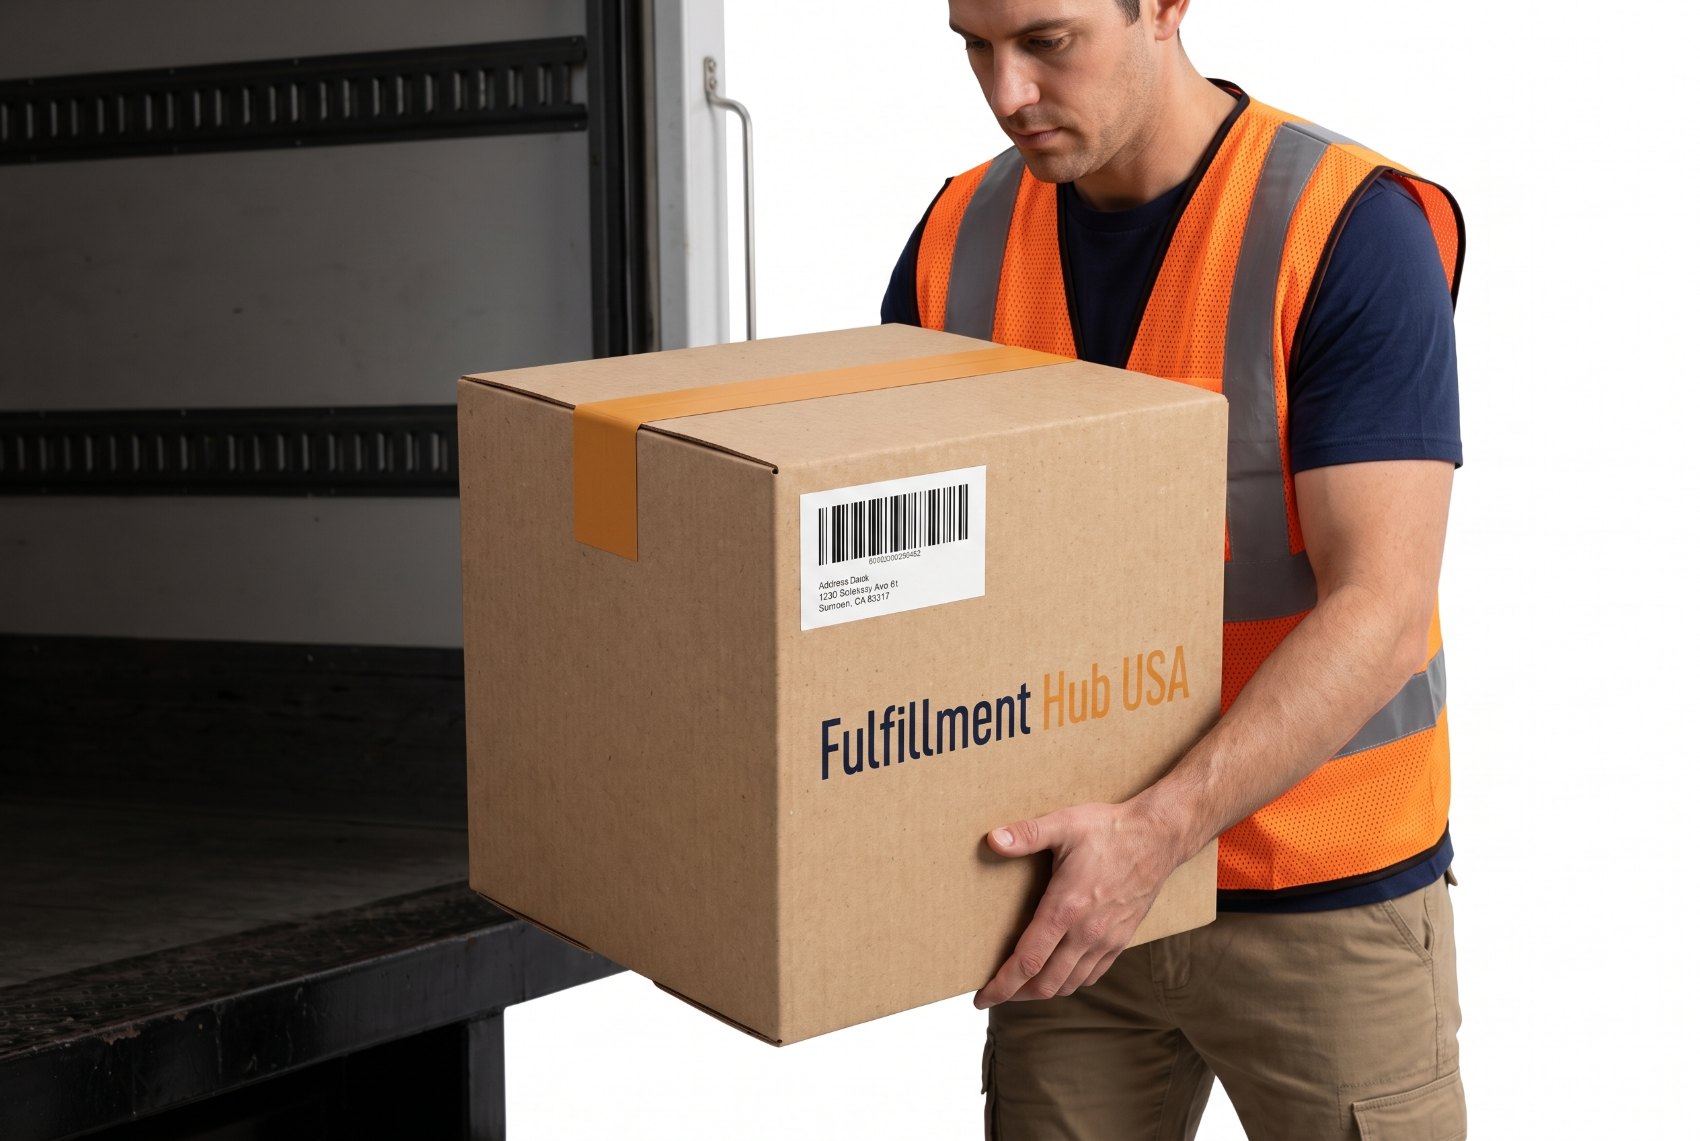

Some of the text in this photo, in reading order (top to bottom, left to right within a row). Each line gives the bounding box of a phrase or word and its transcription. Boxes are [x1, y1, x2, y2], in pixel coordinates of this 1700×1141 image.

[818, 580, 849, 590] Address
[819, 590, 838, 601] 1230
[854, 596, 866, 606] CA
[867, 591, 890, 603] 83317
[821, 645, 1190, 780] Fulfillment Hub USA
